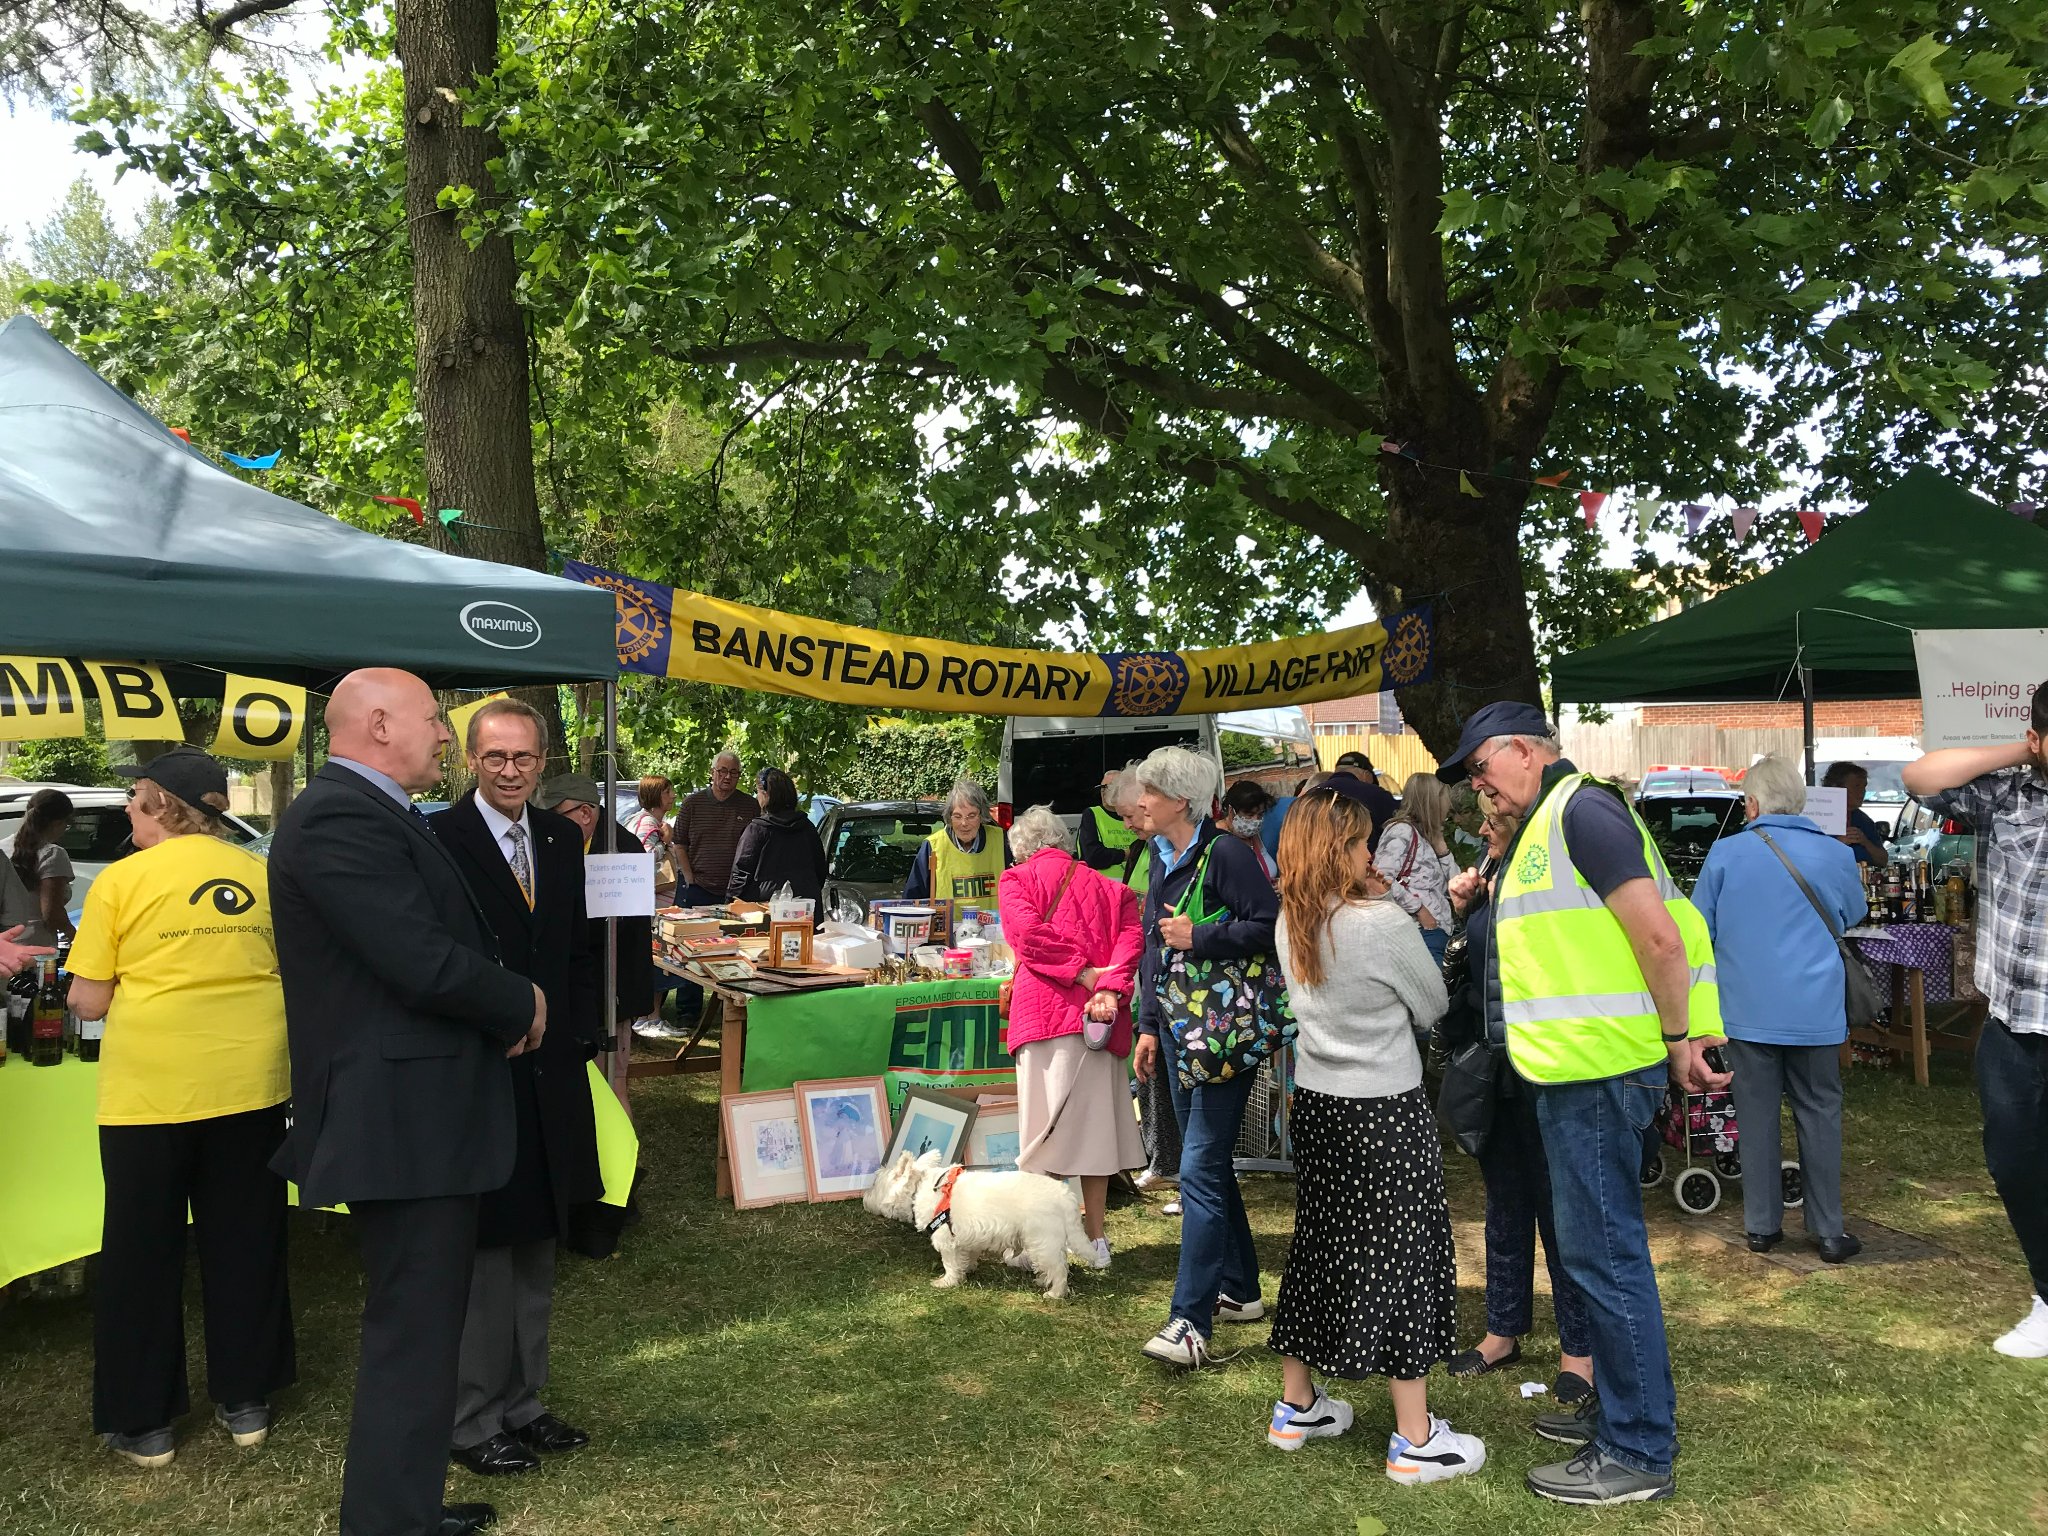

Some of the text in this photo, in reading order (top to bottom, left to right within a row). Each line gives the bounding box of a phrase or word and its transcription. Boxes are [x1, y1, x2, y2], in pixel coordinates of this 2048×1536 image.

[471, 617, 533, 633] MAXIMUS
[691, 619, 1091, 701] BANSTEAD ROTARY
[1201, 654, 1321, 699] VILLAGE
[1319, 643, 1376, 684] FAIR
[1985, 703, 2031, 721] living
[589, 863, 637, 872] Tickets ending
[895, 995, 931, 1007] EPSOM
[933, 991, 974, 1003] MEDICAL
